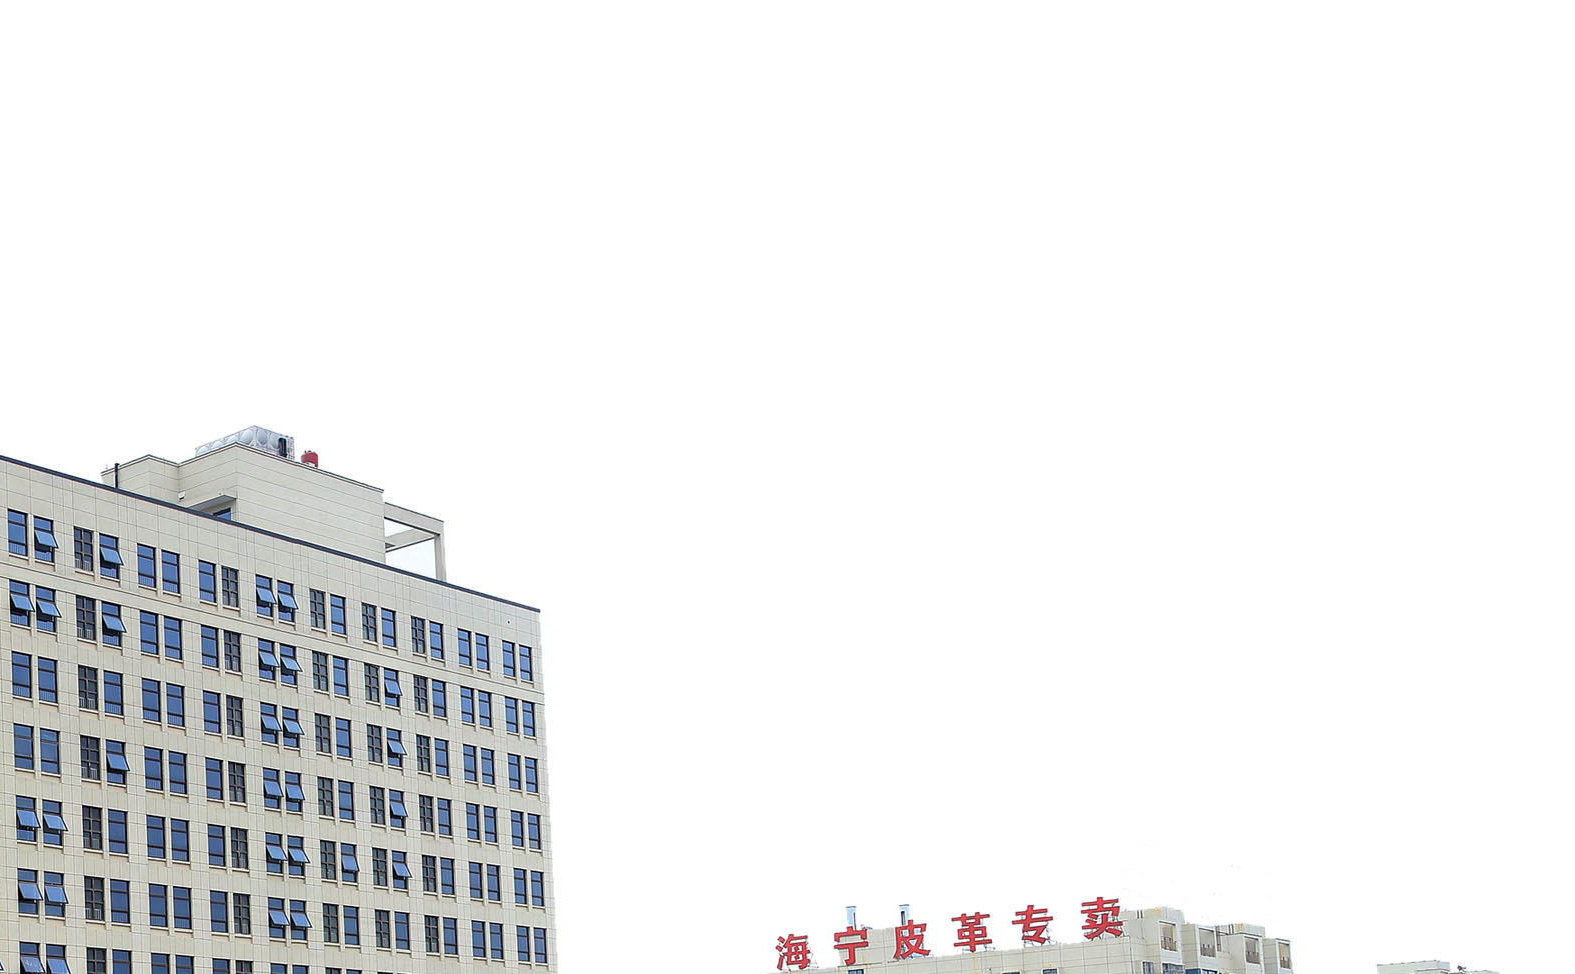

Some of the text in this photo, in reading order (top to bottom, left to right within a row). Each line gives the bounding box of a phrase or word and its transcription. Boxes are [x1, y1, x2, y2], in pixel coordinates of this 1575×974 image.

[776, 896, 1125, 972] 海宁皮革专卖
